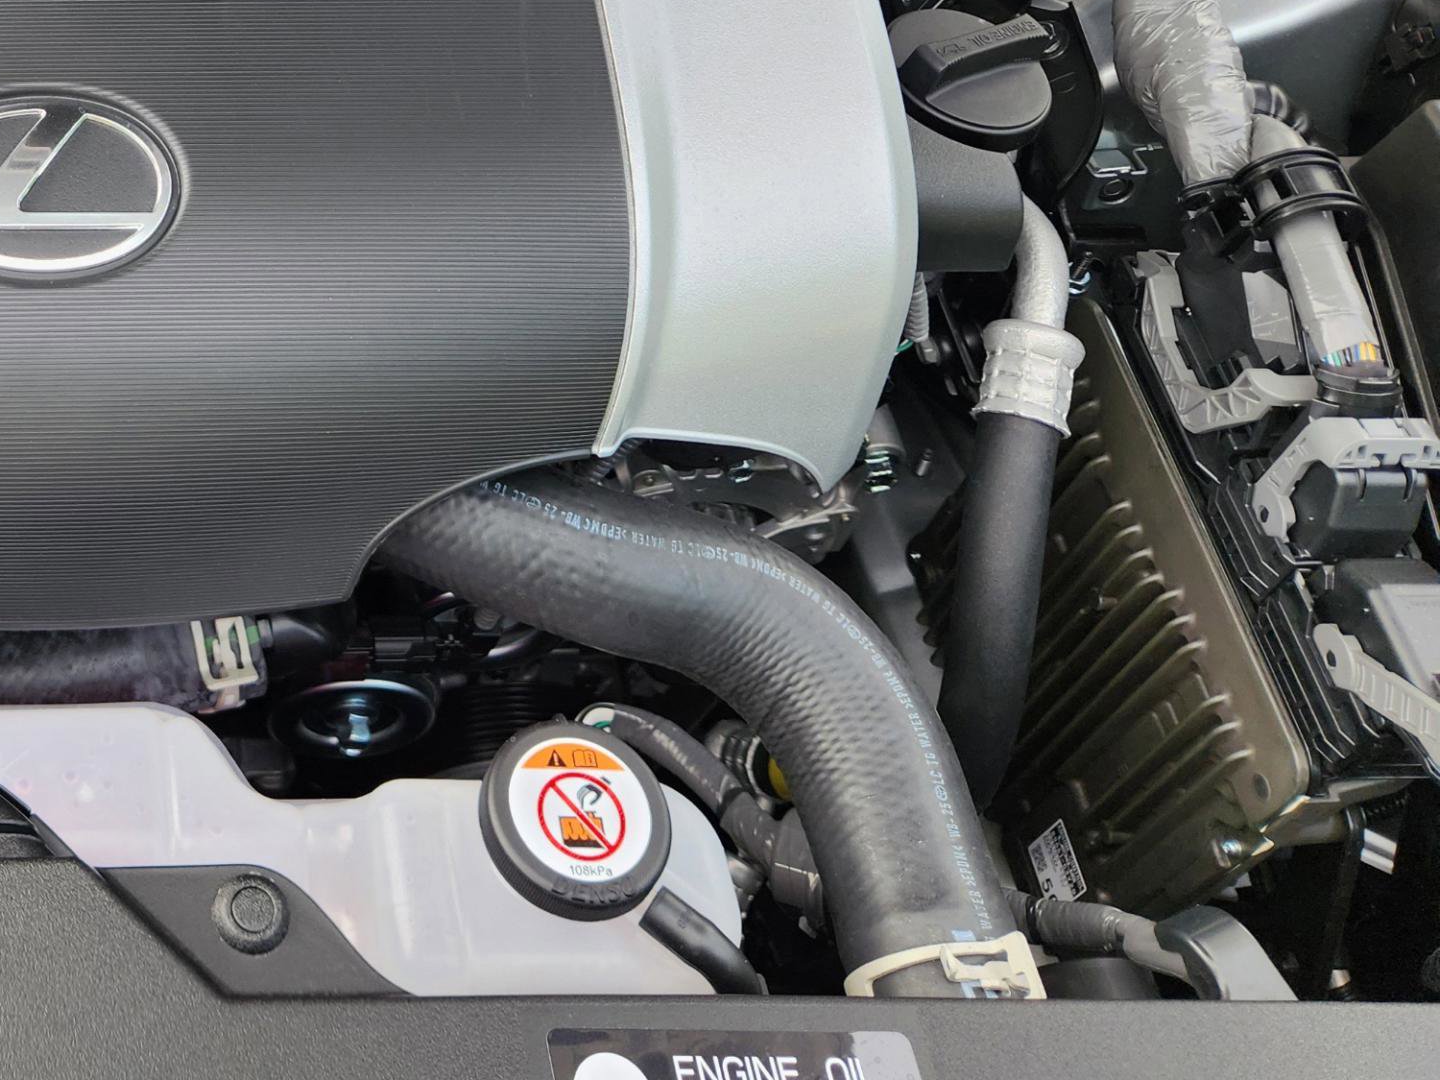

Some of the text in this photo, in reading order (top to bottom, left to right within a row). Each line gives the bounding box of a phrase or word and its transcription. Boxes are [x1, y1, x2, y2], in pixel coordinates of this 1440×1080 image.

[631, 530, 668, 550] WATER
[788, 574, 822, 605] WATER
[908, 711, 932, 749] WATER
[569, 864, 614, 877] 108kPa
[550, 878, 636, 904] DENSO
[671, 1055, 800, 1080] ENGINE
